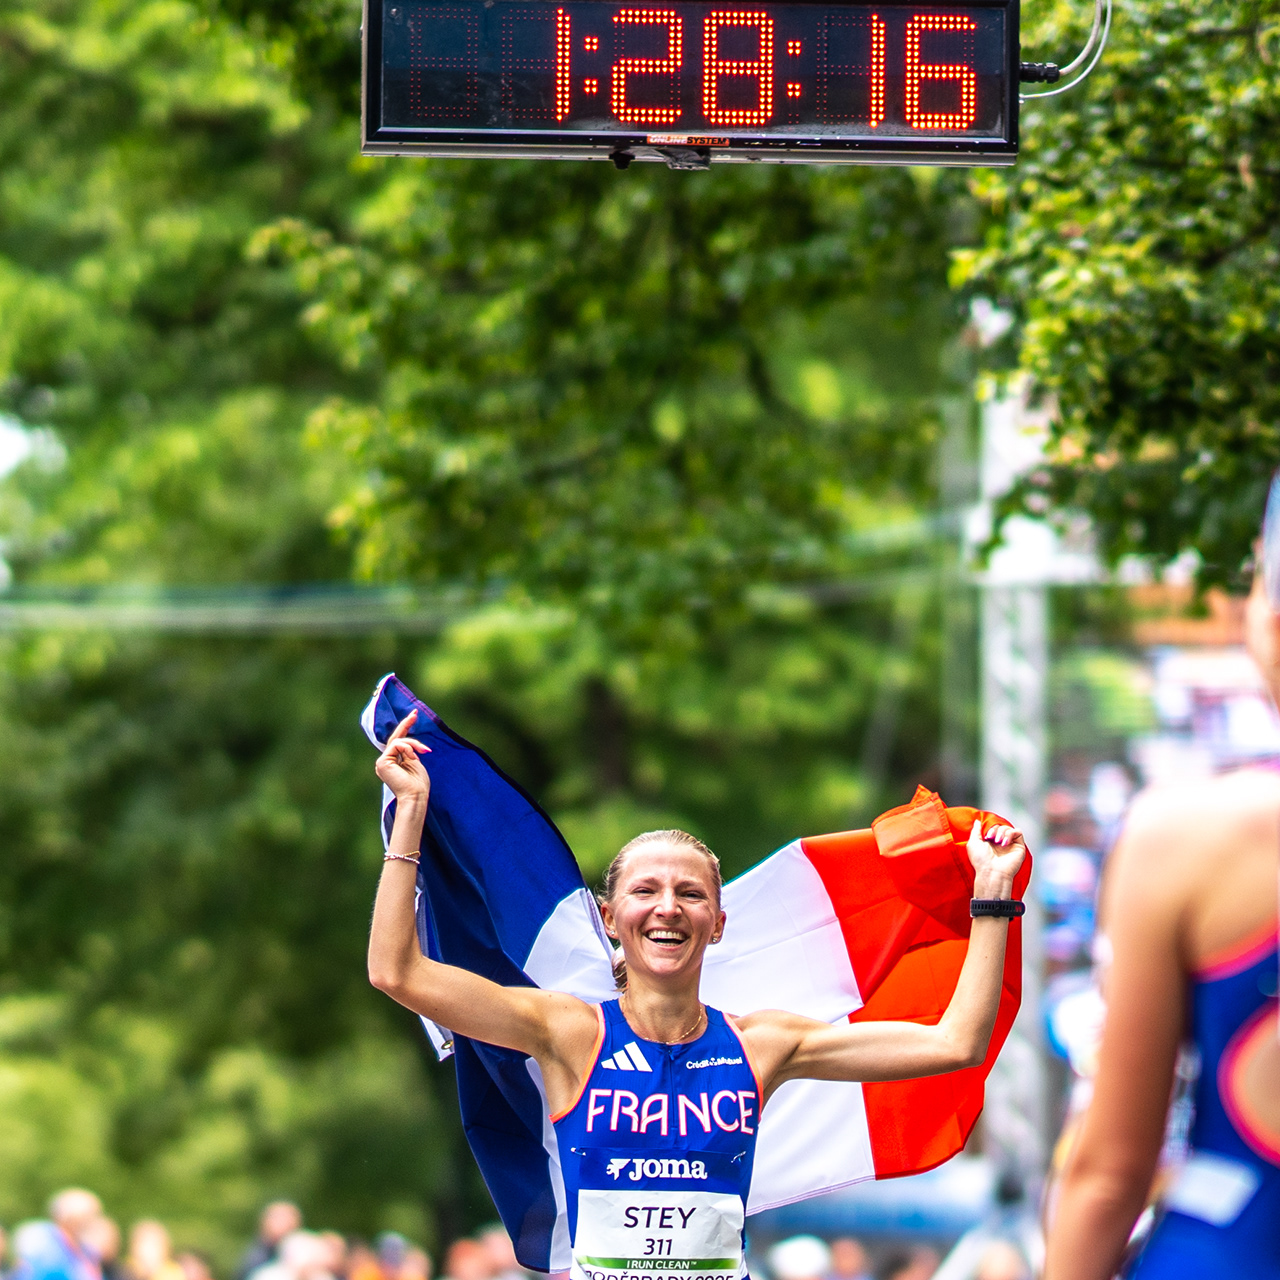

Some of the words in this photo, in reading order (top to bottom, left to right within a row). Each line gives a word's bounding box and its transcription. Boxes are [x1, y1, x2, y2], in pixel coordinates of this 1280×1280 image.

[556, 8, 978, 130] 1:28:16
[586, 1088, 756, 1137] FRANCE
[623, 1206, 697, 1230] STEY
[642, 1238, 673, 1256] 311
[631, 1260, 655, 1270] RUN
